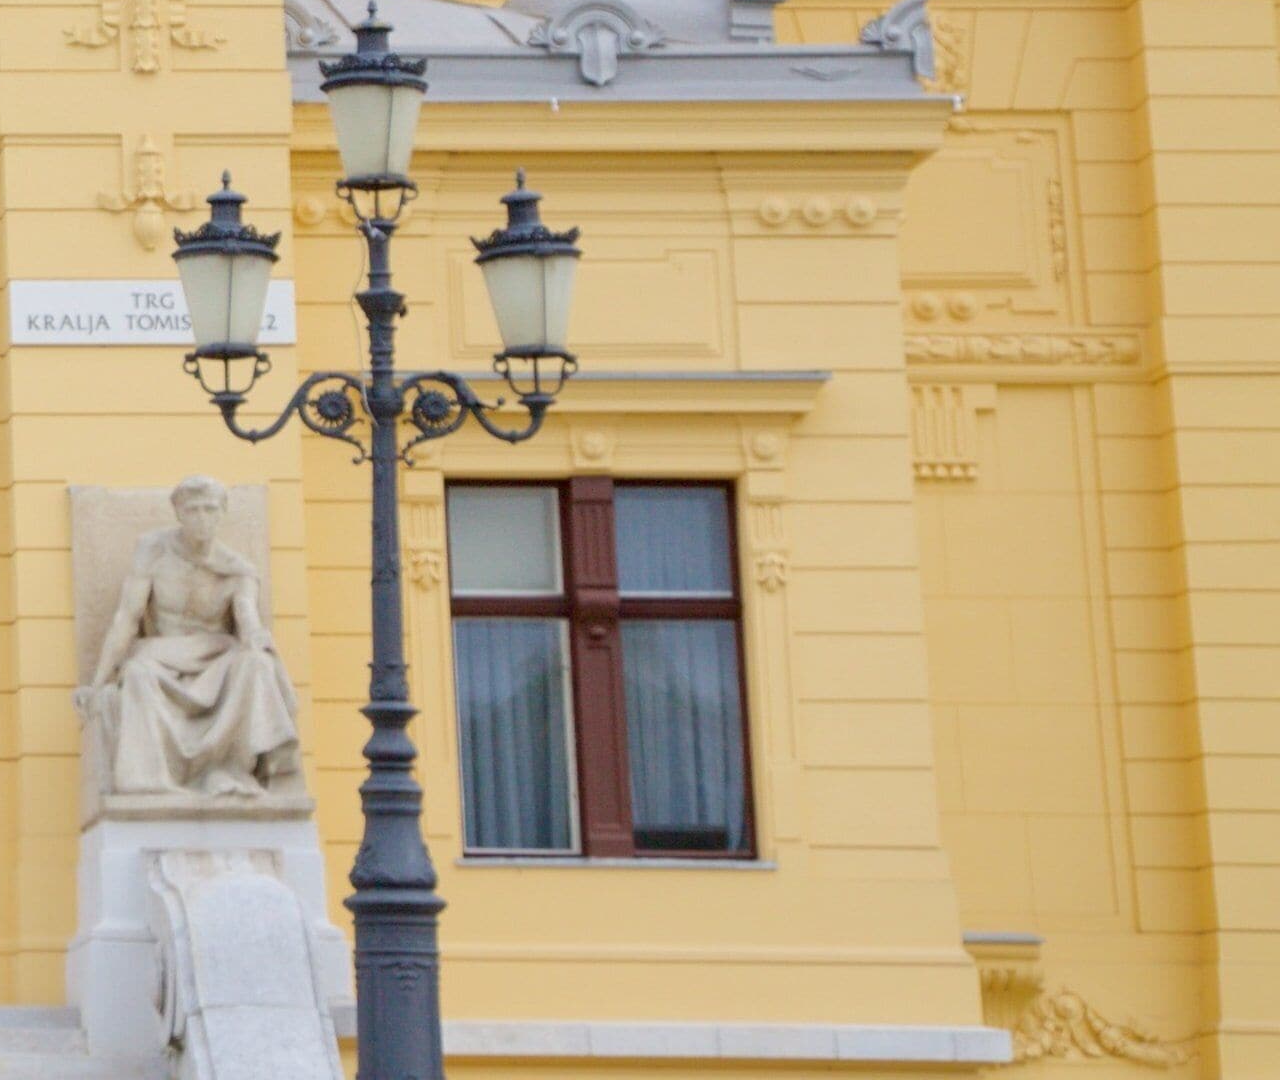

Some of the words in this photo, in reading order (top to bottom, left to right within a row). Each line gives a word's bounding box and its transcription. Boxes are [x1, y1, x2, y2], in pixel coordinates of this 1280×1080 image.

[131, 292, 175, 310] TRG
[27, 314, 110, 335] KRALJA
[126, 314, 192, 330] TOMIS
